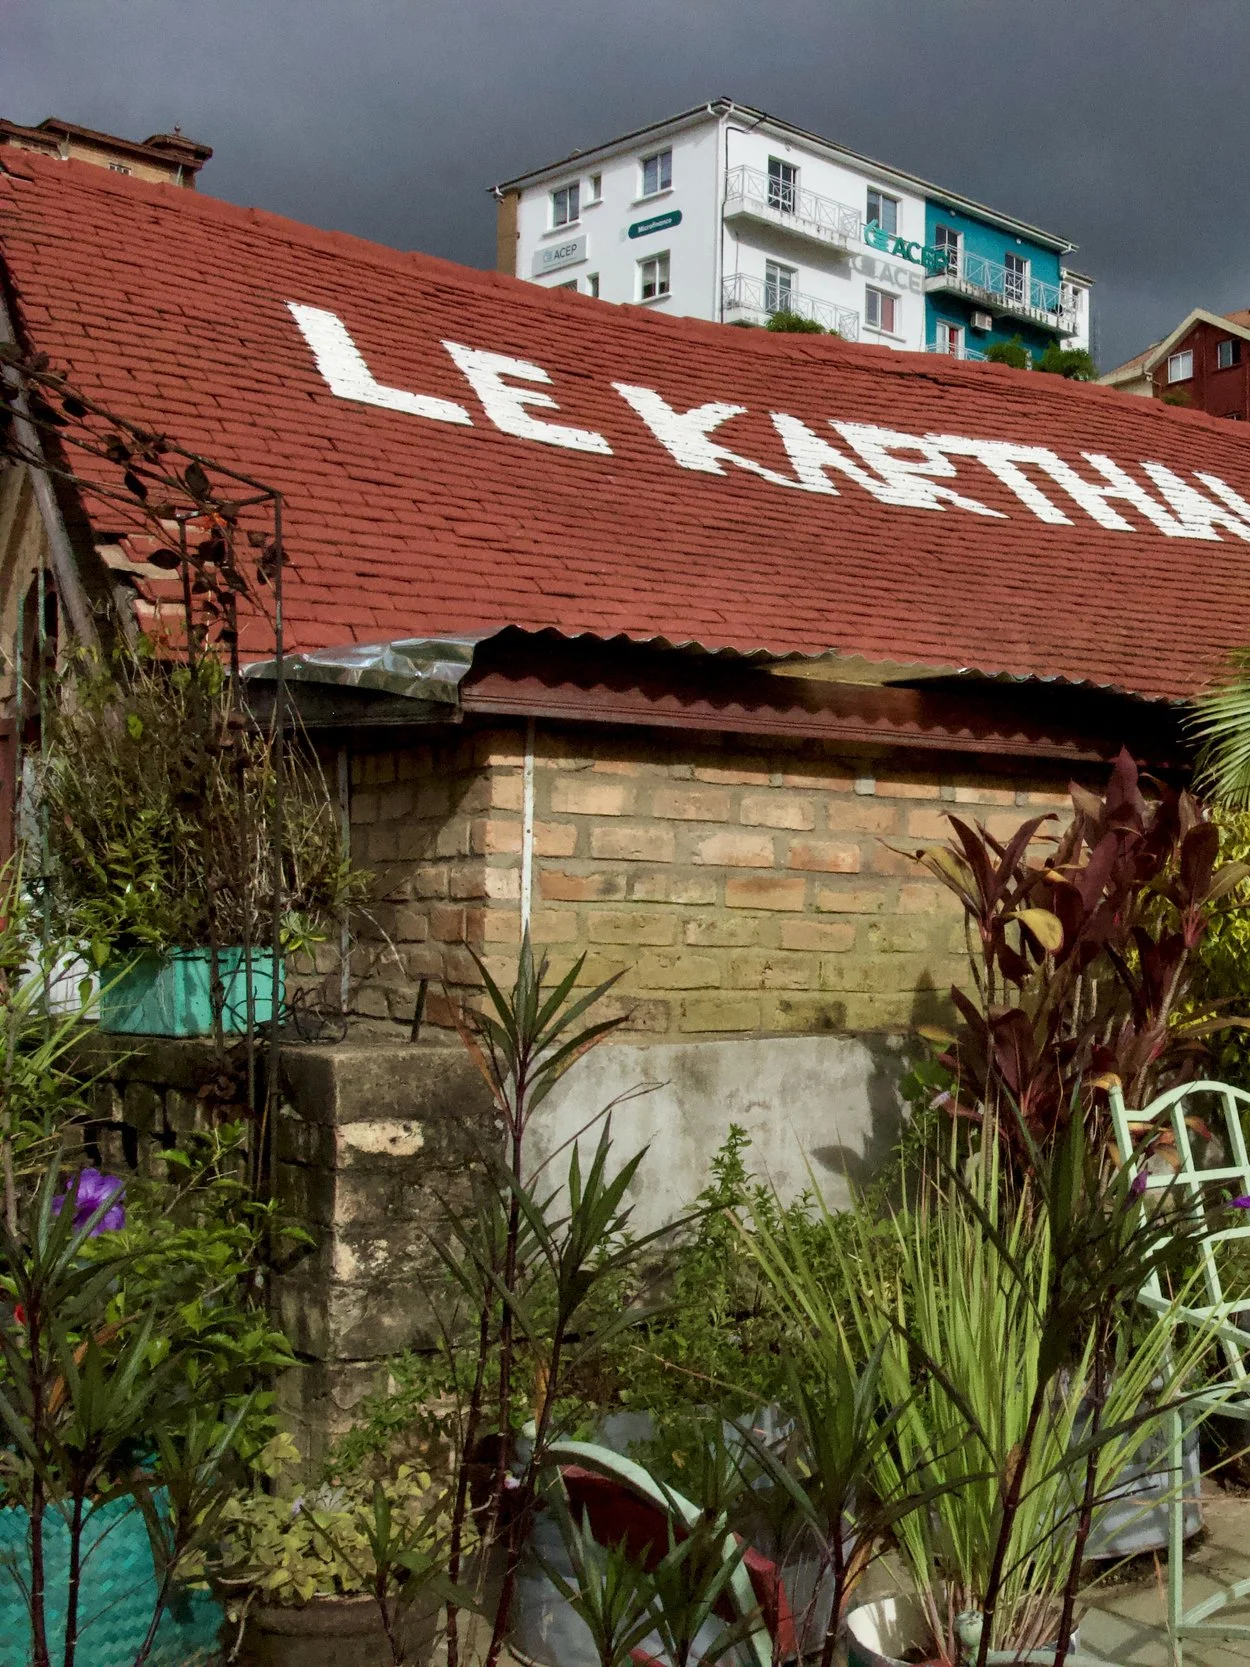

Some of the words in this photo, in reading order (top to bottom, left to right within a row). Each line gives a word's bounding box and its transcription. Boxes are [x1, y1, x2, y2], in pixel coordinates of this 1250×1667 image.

[638, 217, 673, 234] Microfinance
[554, 243, 577, 260] ACEP
[892, 236, 950, 272] ACEP
[285, 300, 614, 455] LE
